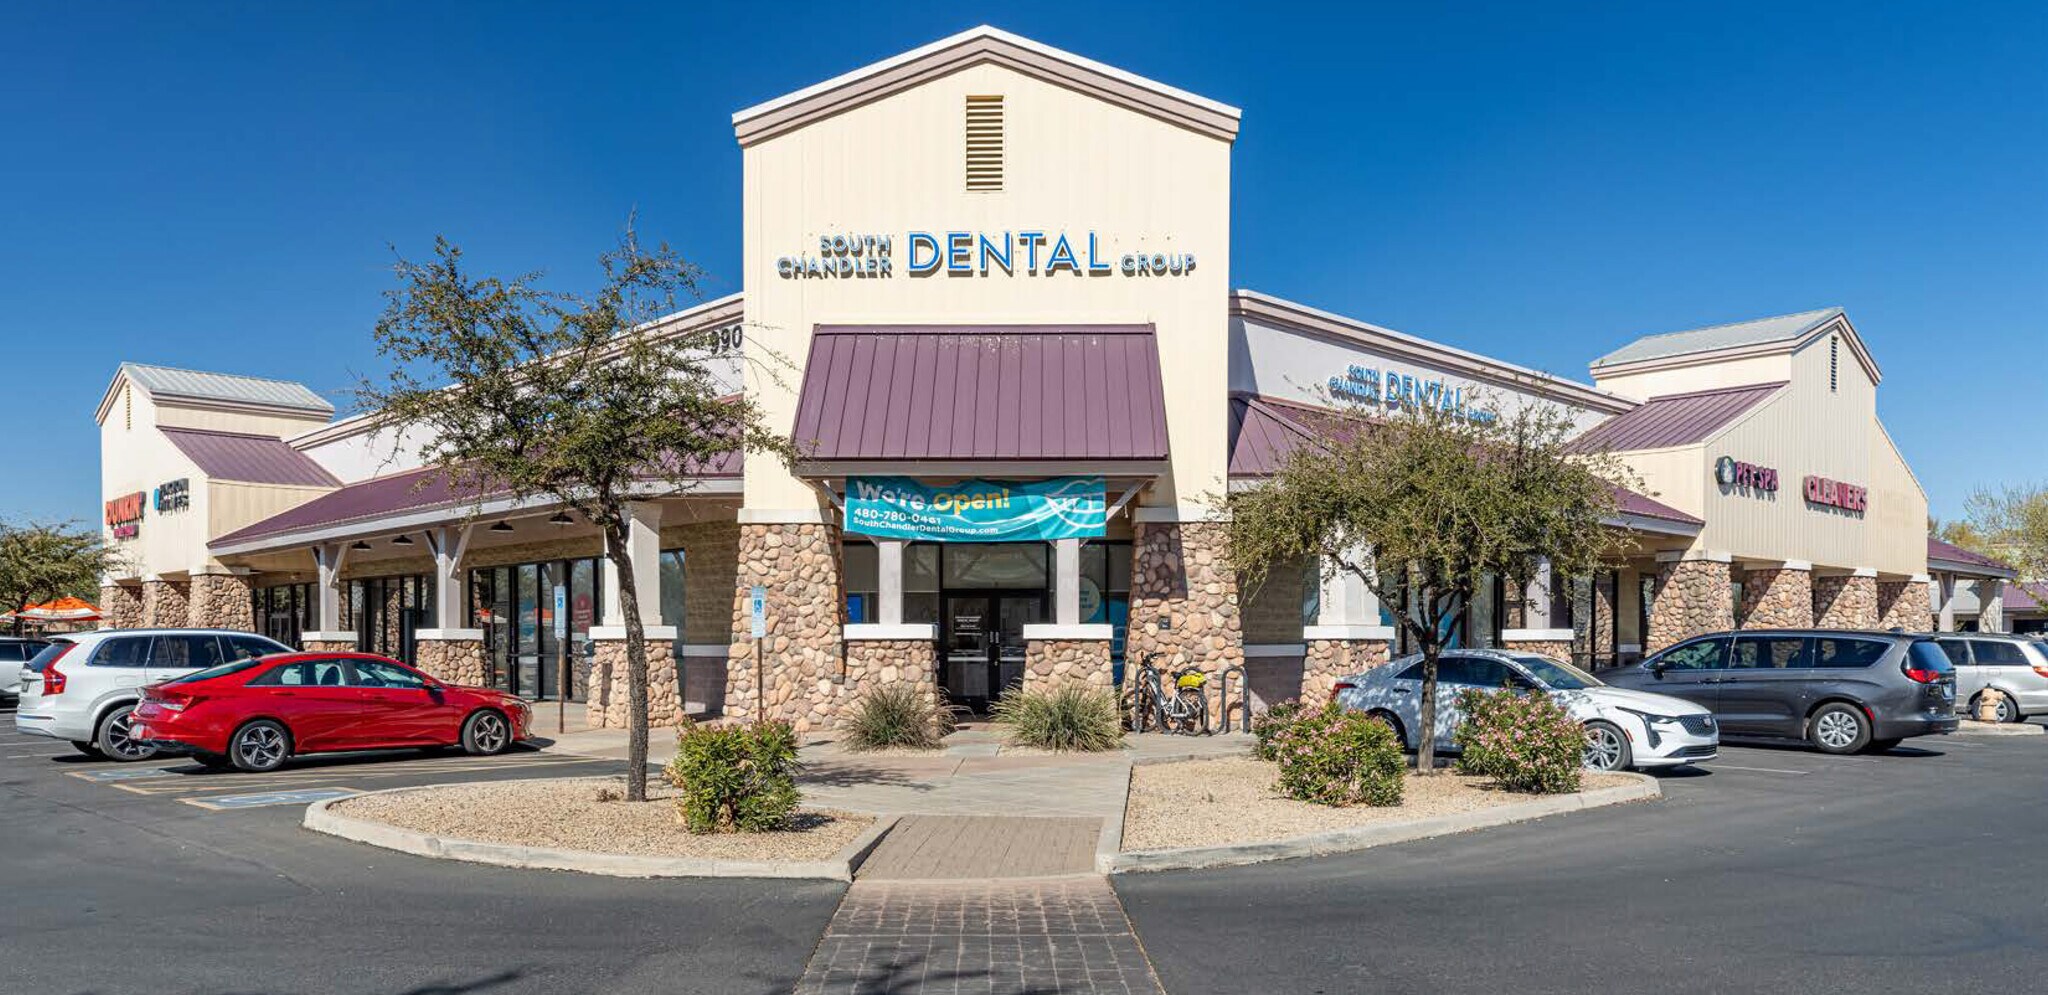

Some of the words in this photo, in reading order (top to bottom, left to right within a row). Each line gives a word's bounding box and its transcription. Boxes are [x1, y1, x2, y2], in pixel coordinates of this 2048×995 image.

[820, 234, 891, 256] SOUTH
[907, 231, 1111, 277] DENTAL
[1121, 253, 1196, 277] GROUP
[777, 257, 892, 279] CHANDLER
[1736, 461, 1756, 488] PET
[1758, 467, 1779, 491] SPA
[932, 488, 1010, 516] Open!
[1803, 475, 1867, 511] CLEANERS
[853, 517, 999, 534] SouthChandlerDentalGroup.com
